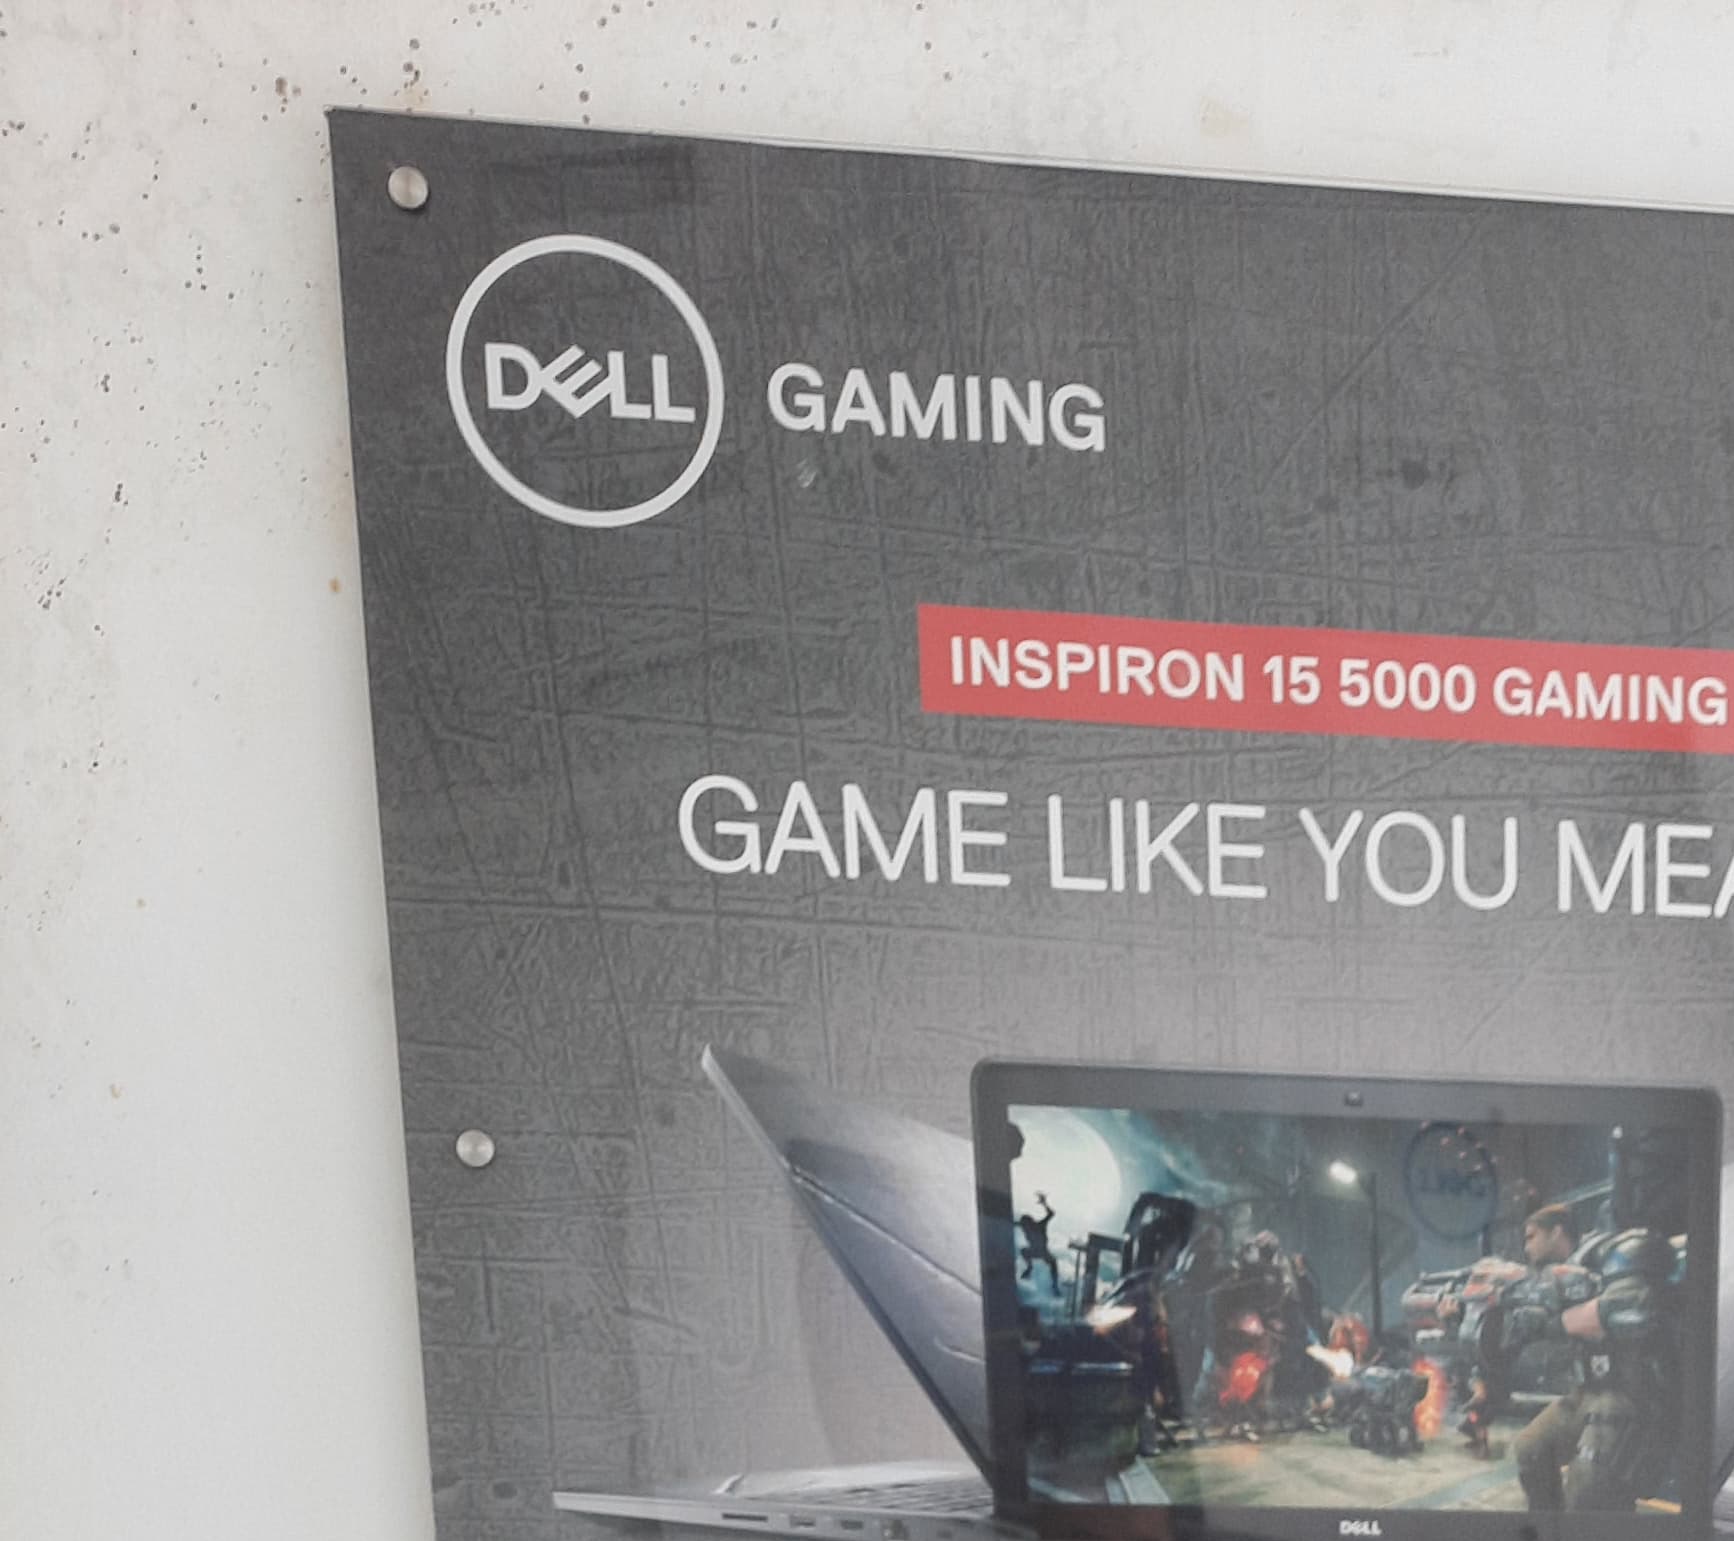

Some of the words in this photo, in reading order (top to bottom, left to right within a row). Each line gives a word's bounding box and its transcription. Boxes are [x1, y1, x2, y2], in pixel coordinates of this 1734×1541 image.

[484, 342, 697, 422] DELL
[766, 364, 1107, 452] GAMING
[949, 635, 1245, 703] INSPIRON
[1263, 654, 1321, 704] 15
[1338, 660, 1476, 713] 5000
[1493, 668, 1729, 727] GAMING
[678, 775, 1011, 888] GAME
[1048, 793, 1268, 899] LIKE
[1299, 807, 1519, 910] YOU
[1339, 1519, 1382, 1536] DELL
